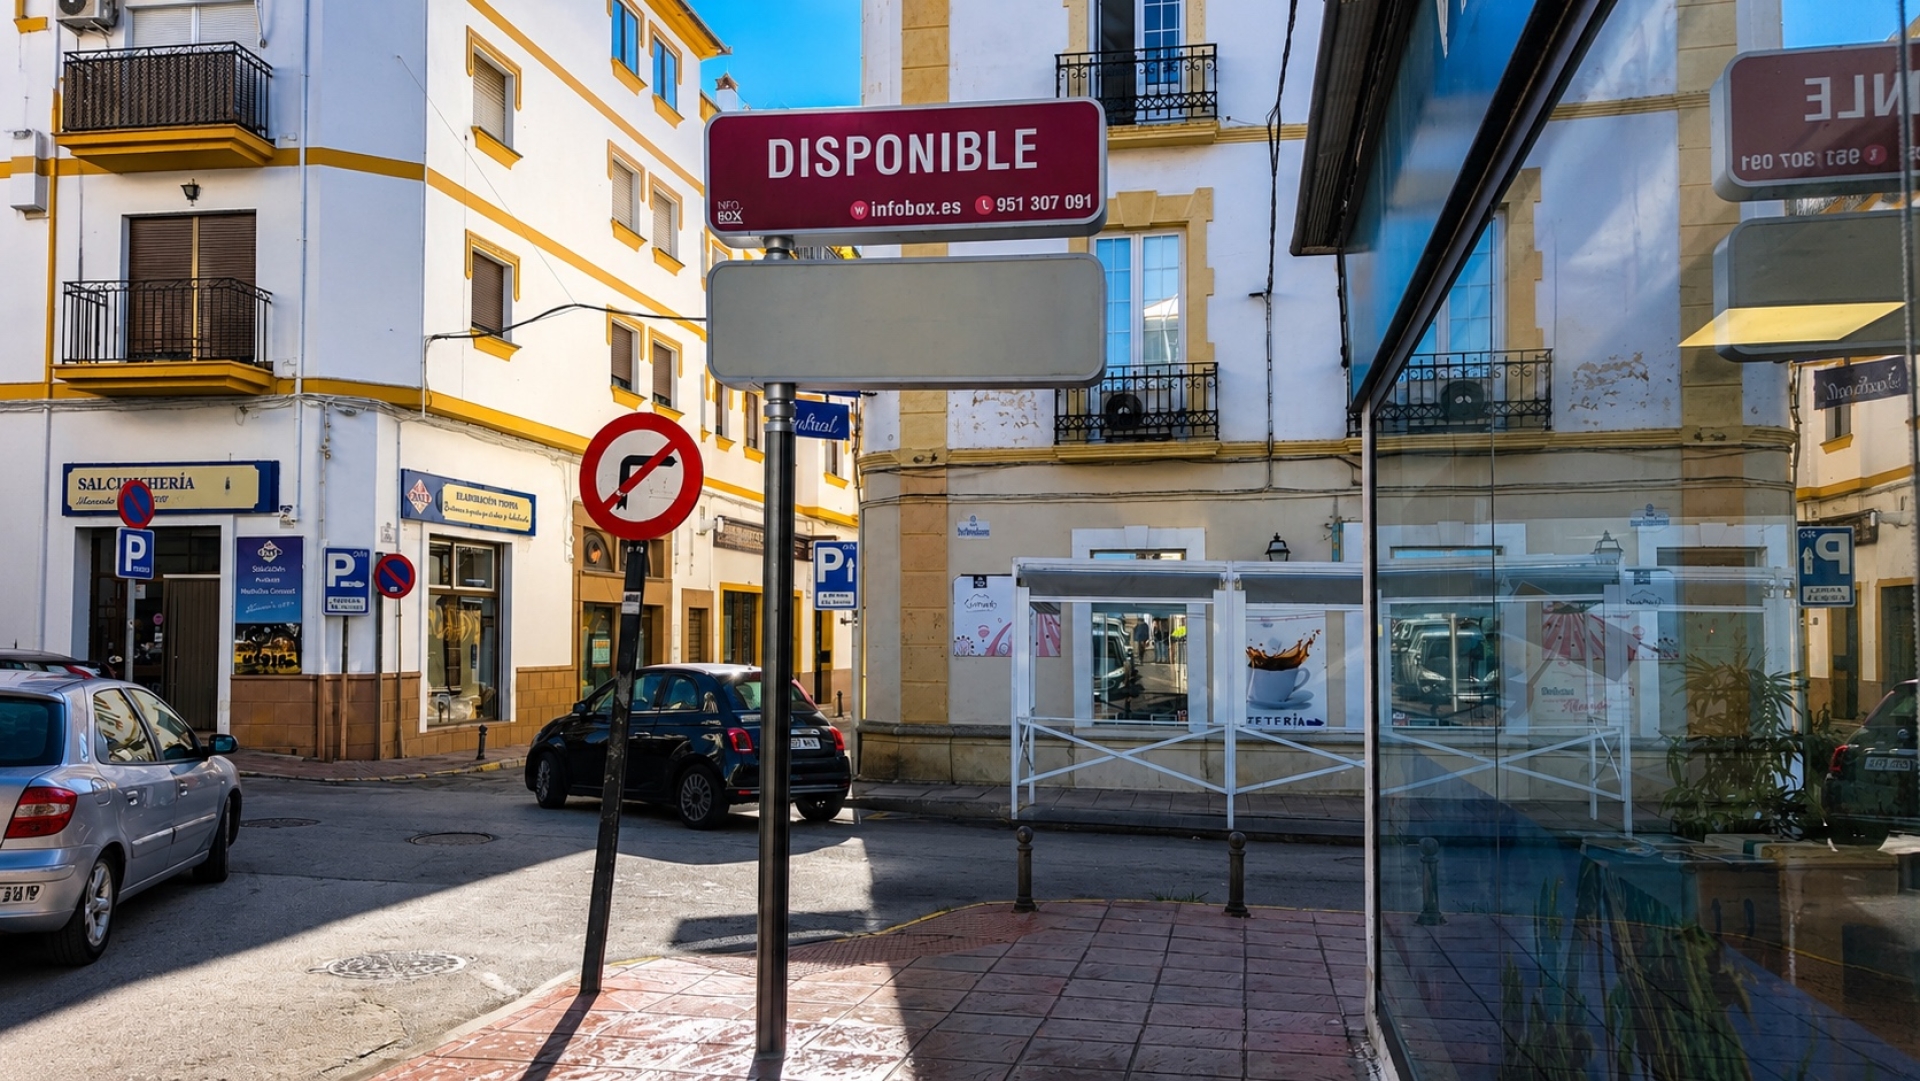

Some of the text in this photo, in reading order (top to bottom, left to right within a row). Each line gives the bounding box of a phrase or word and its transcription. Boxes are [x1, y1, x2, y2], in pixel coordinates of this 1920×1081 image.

[768, 128, 1037, 179] DISPONIBLE
[871, 201, 961, 217] infobox.es
[997, 193, 1092, 212] 951 307 091
[78, 472, 195, 490] SALCHERÍA
[125, 534, 147, 572] P
[327, 552, 356, 587] P
[817, 547, 845, 583] P
